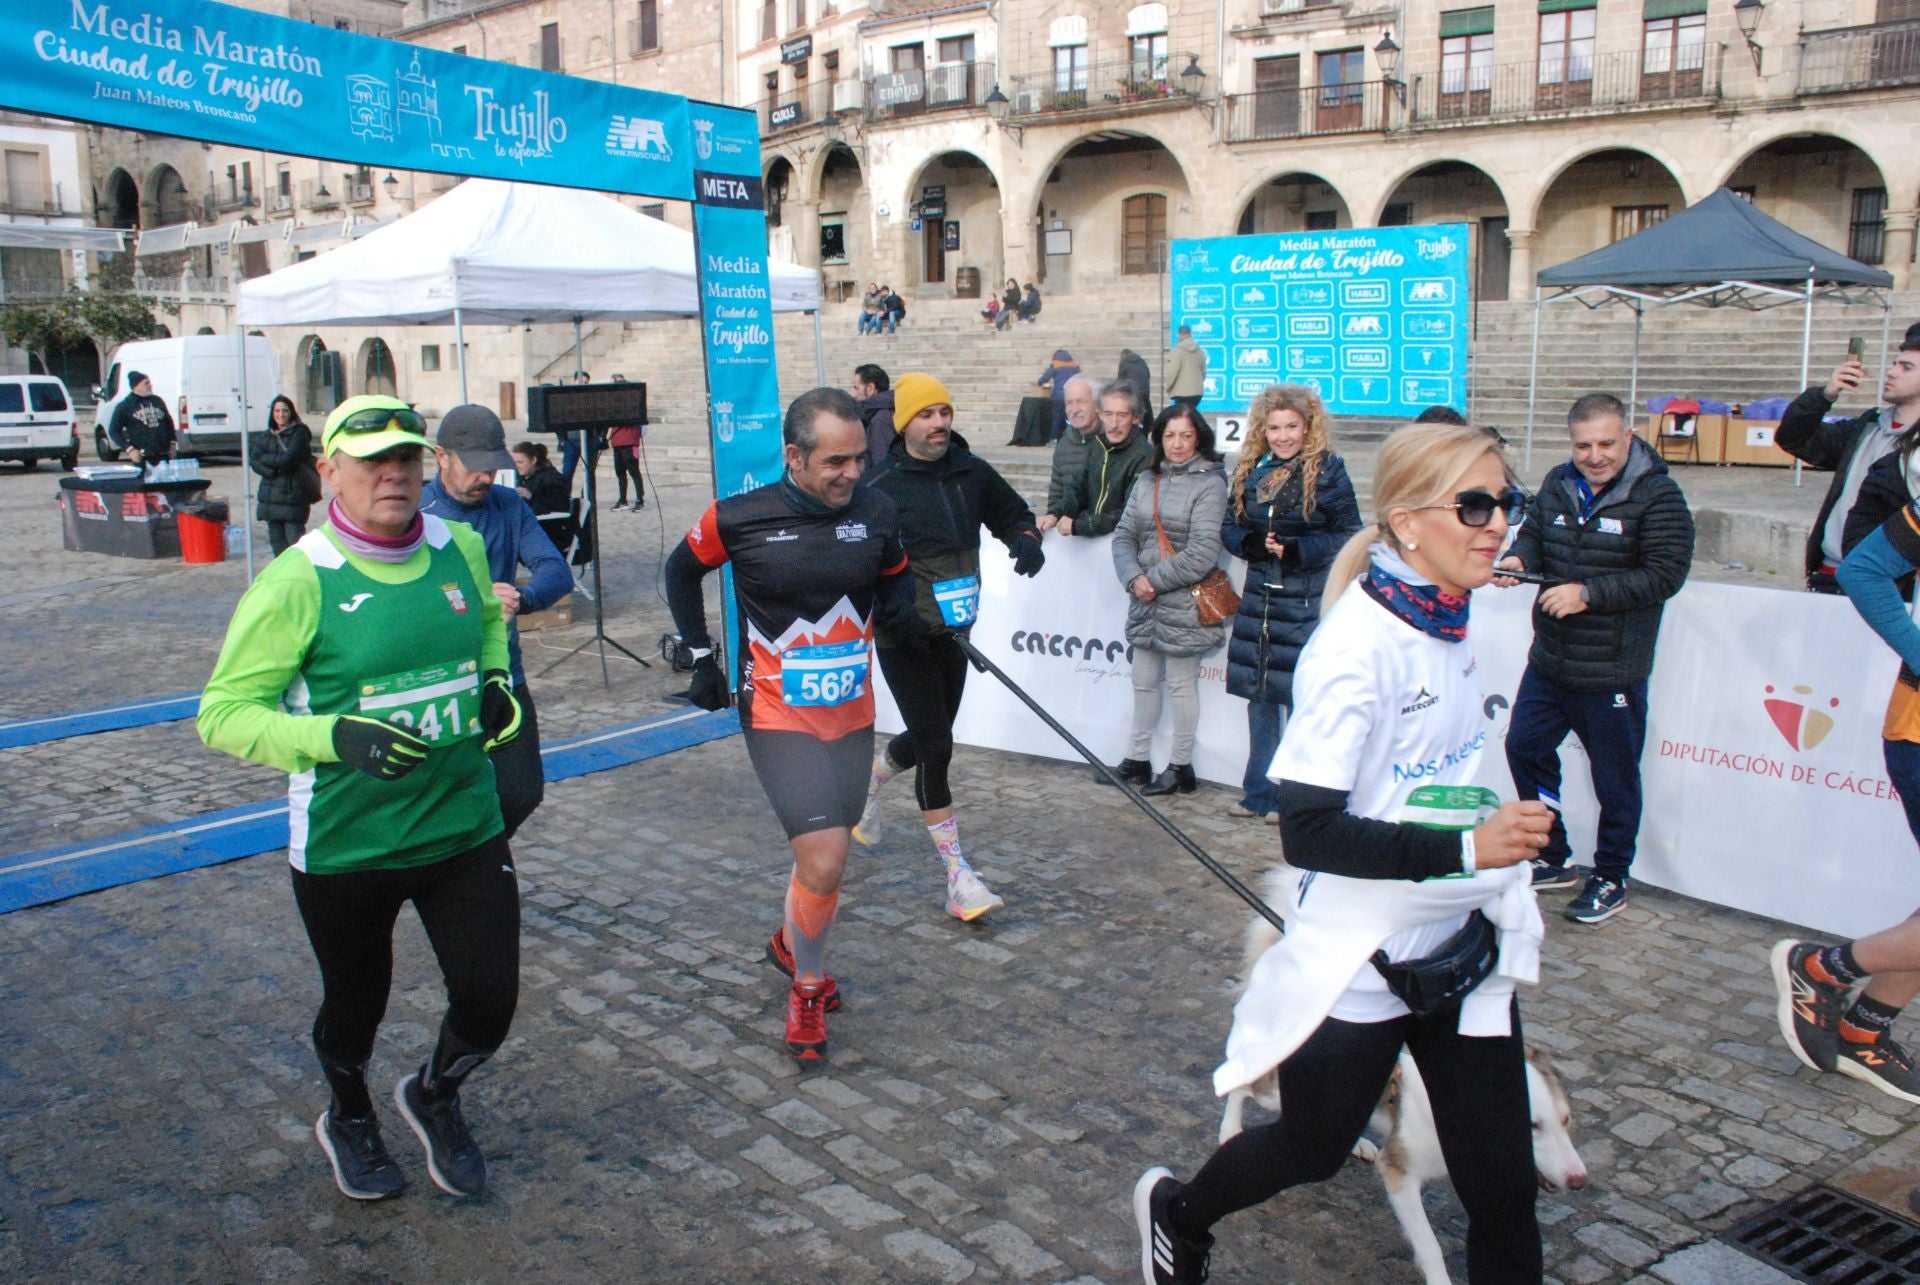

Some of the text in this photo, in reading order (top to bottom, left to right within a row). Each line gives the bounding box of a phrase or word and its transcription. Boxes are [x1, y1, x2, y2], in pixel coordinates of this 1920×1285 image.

[70, 0, 323, 78] Media Maratón
[33, 30, 304, 112] Ciudad de Trujillo
[93, 82, 257, 124] Juan Mateos Broncano
[463, 83, 567, 152] Trujillo
[703, 178, 749, 201] META
[1279, 236, 1376, 252] Media Maratón
[708, 255, 760, 274] Media
[1230, 249, 1405, 275] Ciudad de Trujillo
[1270, 272, 1286, 281] Juan
[707, 281, 767, 299] Maratón
[1350, 289, 1380, 298] HABLA
[716, 305, 759, 318] Ciudad de
[710, 321, 769, 353] Trujillo
[1295, 321, 1324, 330] HABLA
[1352, 353, 1381, 362] HABLA
[1225, 420, 1240, 442] 2
[952, 596, 977, 623] 53
[801, 669, 856, 702] 568
[1393, 759, 1438, 783] Nos
[1660, 739, 1900, 801] DIPUTACIÓN DE CÁCER
